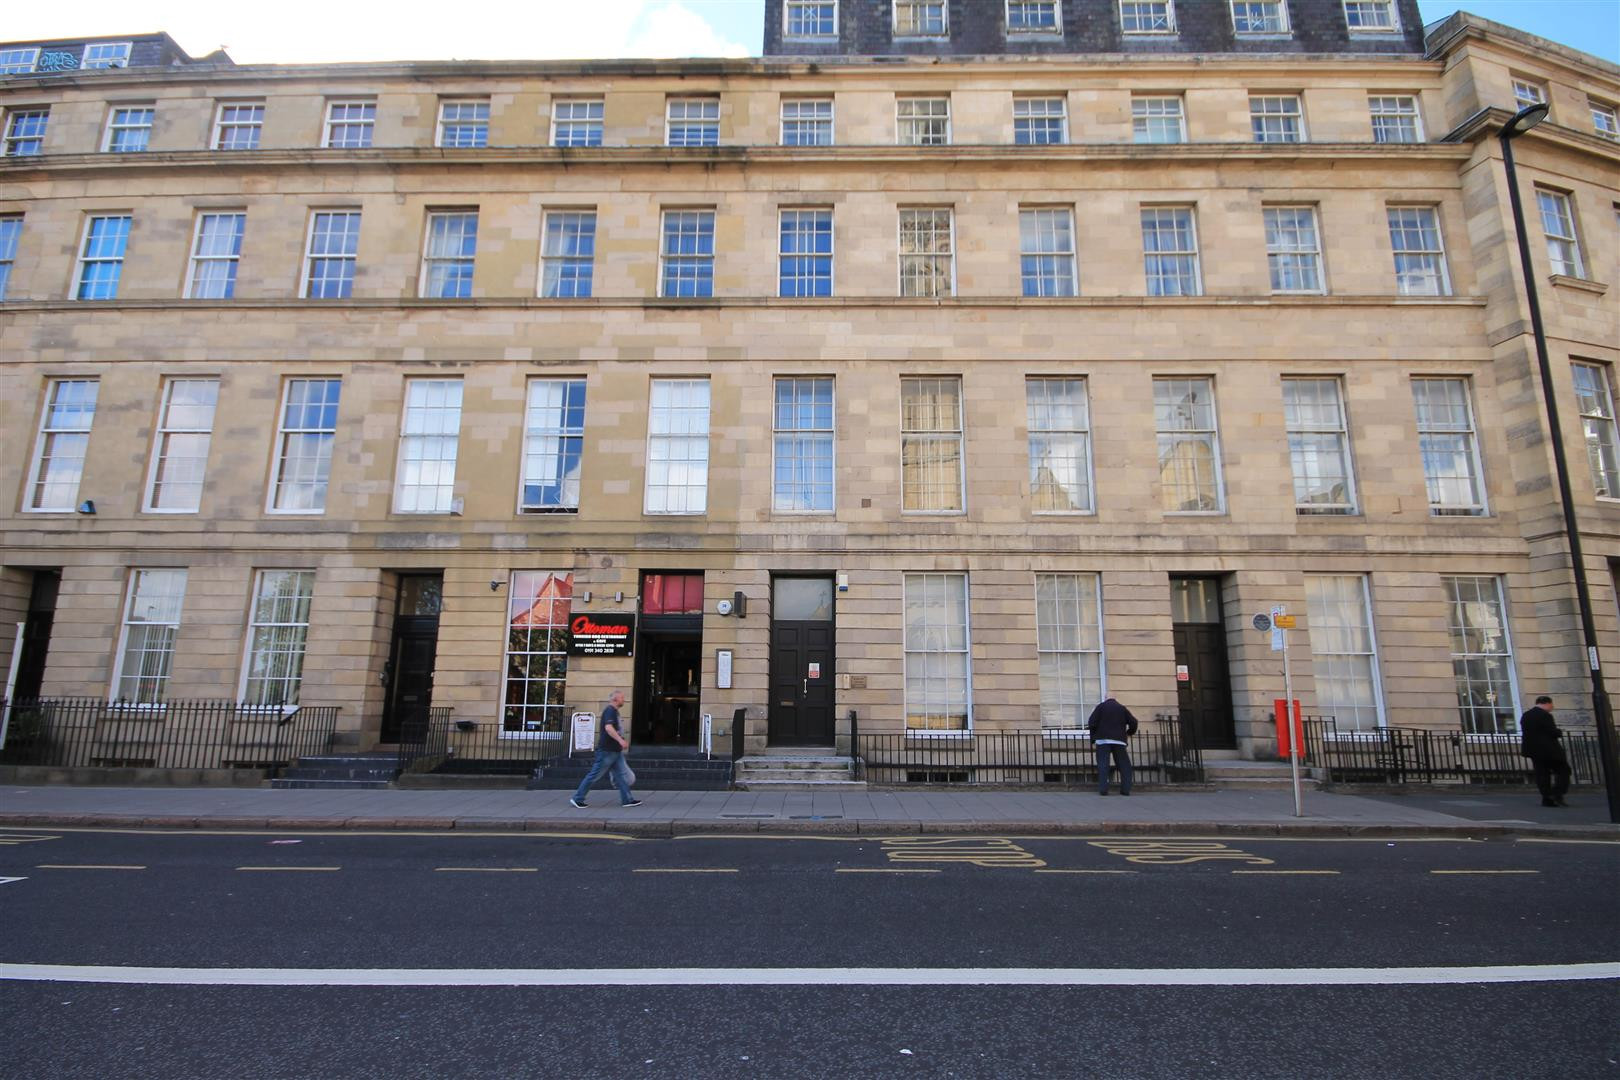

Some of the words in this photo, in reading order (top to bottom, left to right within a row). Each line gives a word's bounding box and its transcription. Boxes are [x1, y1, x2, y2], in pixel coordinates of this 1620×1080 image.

[571, 616, 630, 634] Ottoman
[880, 838, 1047, 867] STOP
[1087, 841, 1275, 864] BUS
